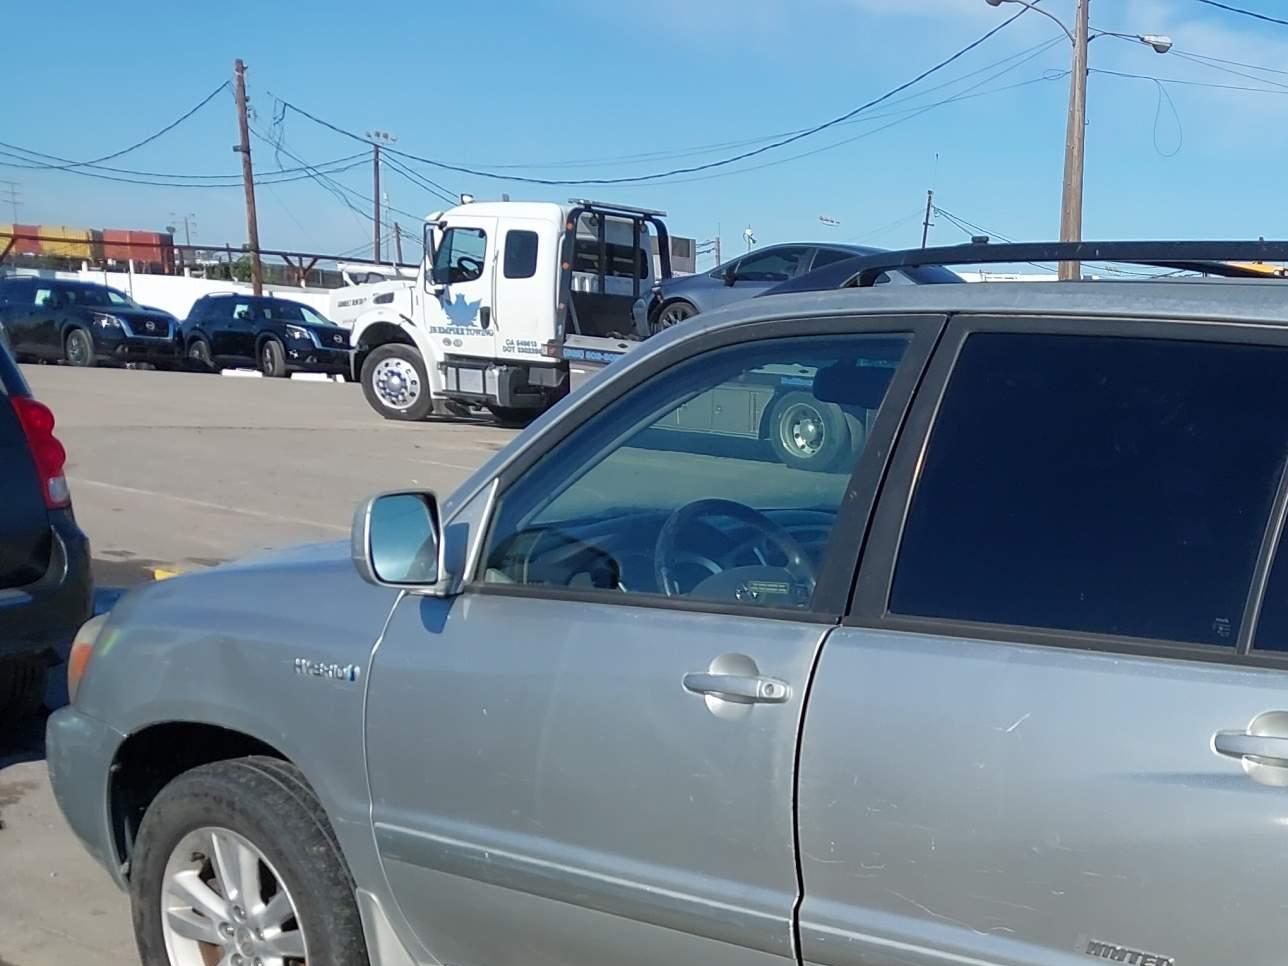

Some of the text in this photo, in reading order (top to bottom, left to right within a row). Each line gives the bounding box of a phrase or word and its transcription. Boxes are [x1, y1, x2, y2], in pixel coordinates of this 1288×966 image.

[466, 328, 494, 336] TOWING
[505, 338, 515, 346] CA
[502, 345, 515, 353] DOT
